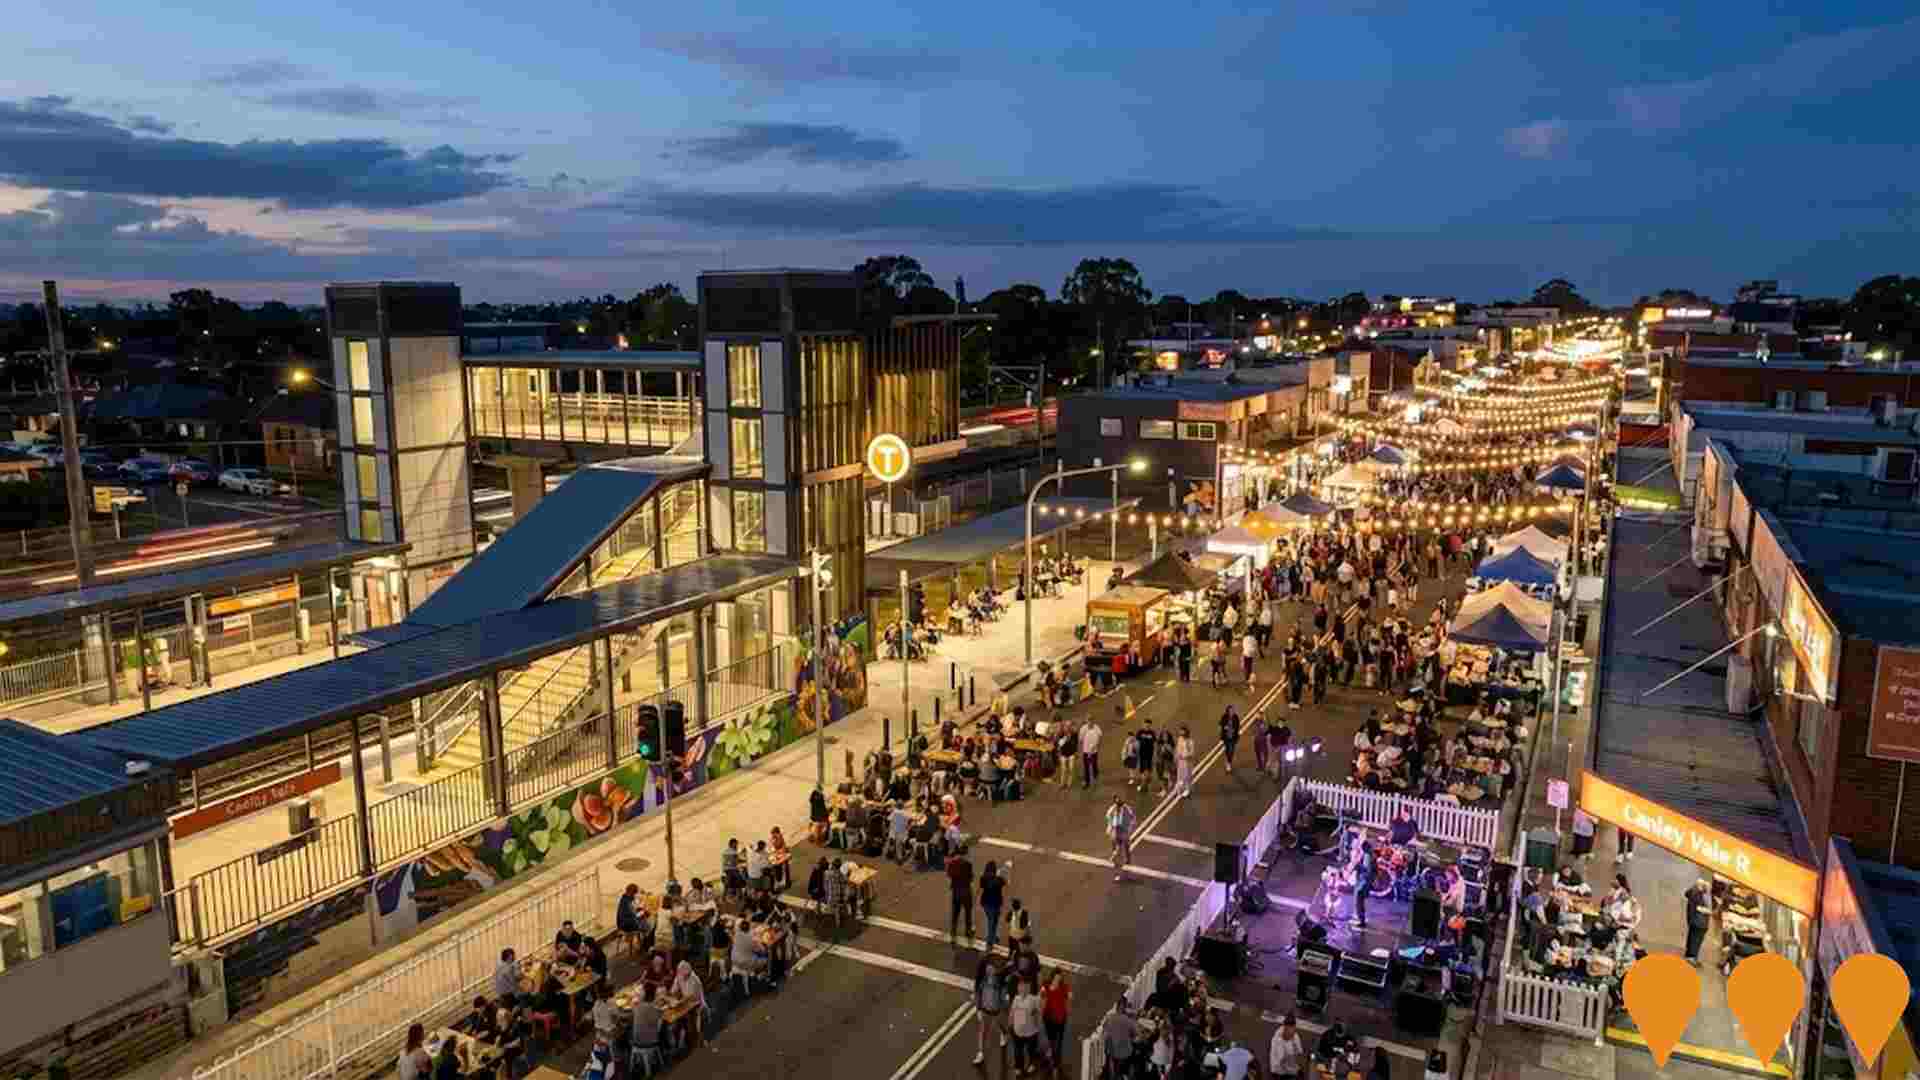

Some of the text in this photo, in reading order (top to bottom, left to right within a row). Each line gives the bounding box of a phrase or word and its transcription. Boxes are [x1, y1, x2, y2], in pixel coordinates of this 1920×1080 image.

[877, 446, 900, 473] T
[1624, 802, 1684, 847] Canley
[1690, 831, 1729, 864] Vale
